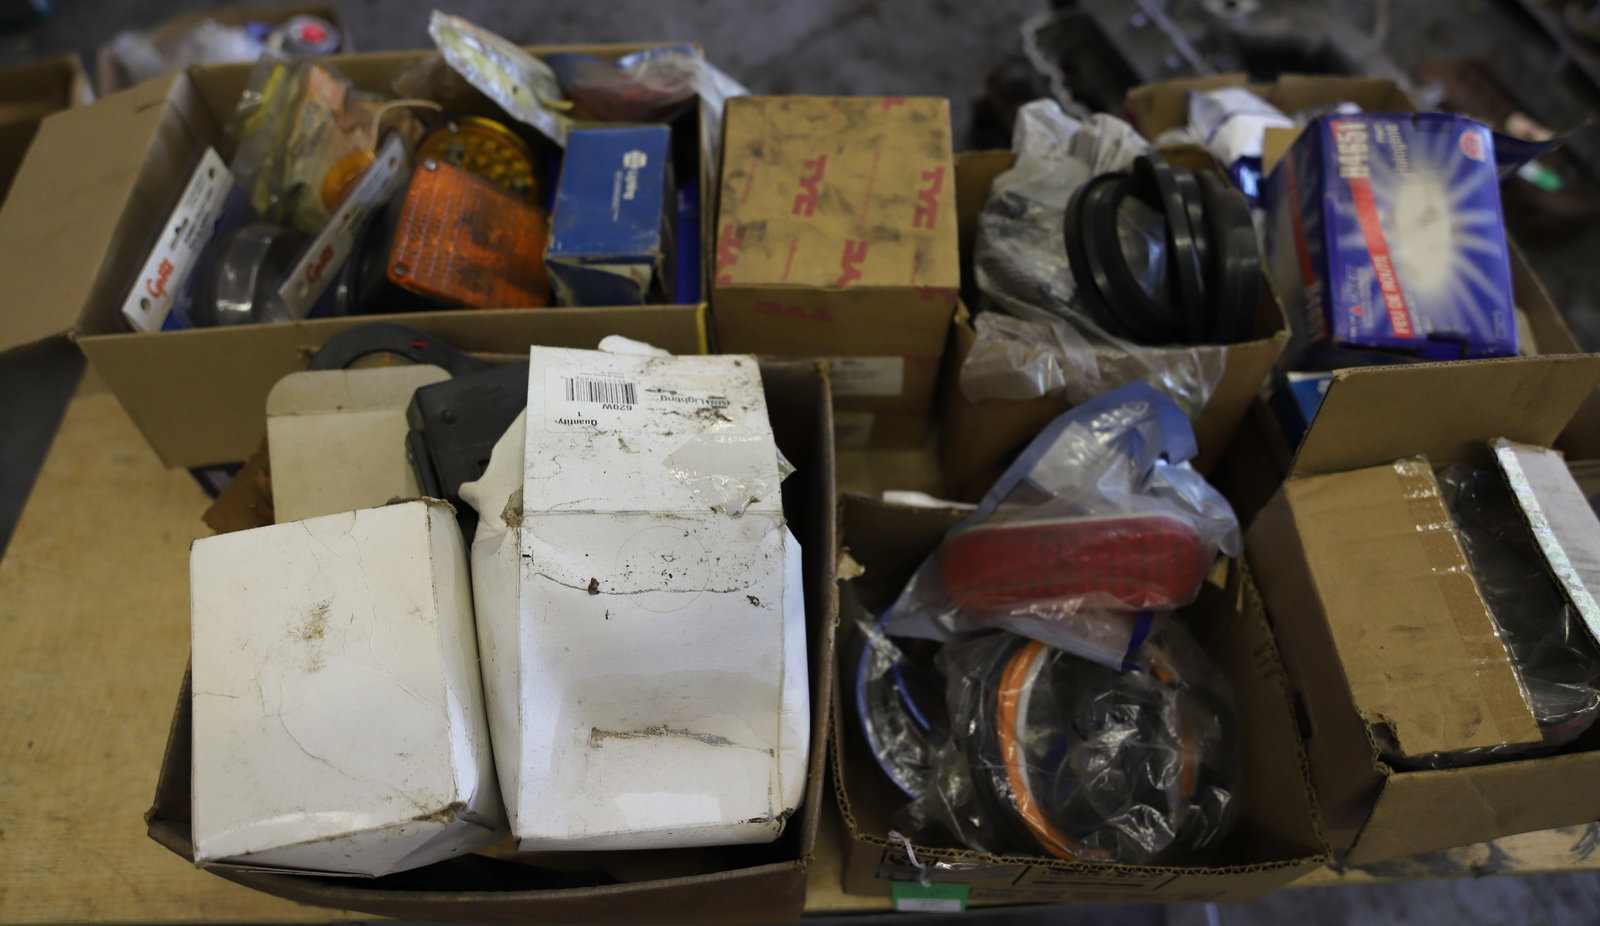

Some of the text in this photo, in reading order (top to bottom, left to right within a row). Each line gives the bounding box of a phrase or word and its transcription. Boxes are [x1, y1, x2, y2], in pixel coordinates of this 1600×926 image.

[792, 155, 828, 217] TYC
[914, 167, 945, 229] TYC
[836, 239, 868, 288] YC
[558, 418, 598, 426] Quantity
[660, 395, 704, 406] Lighting
